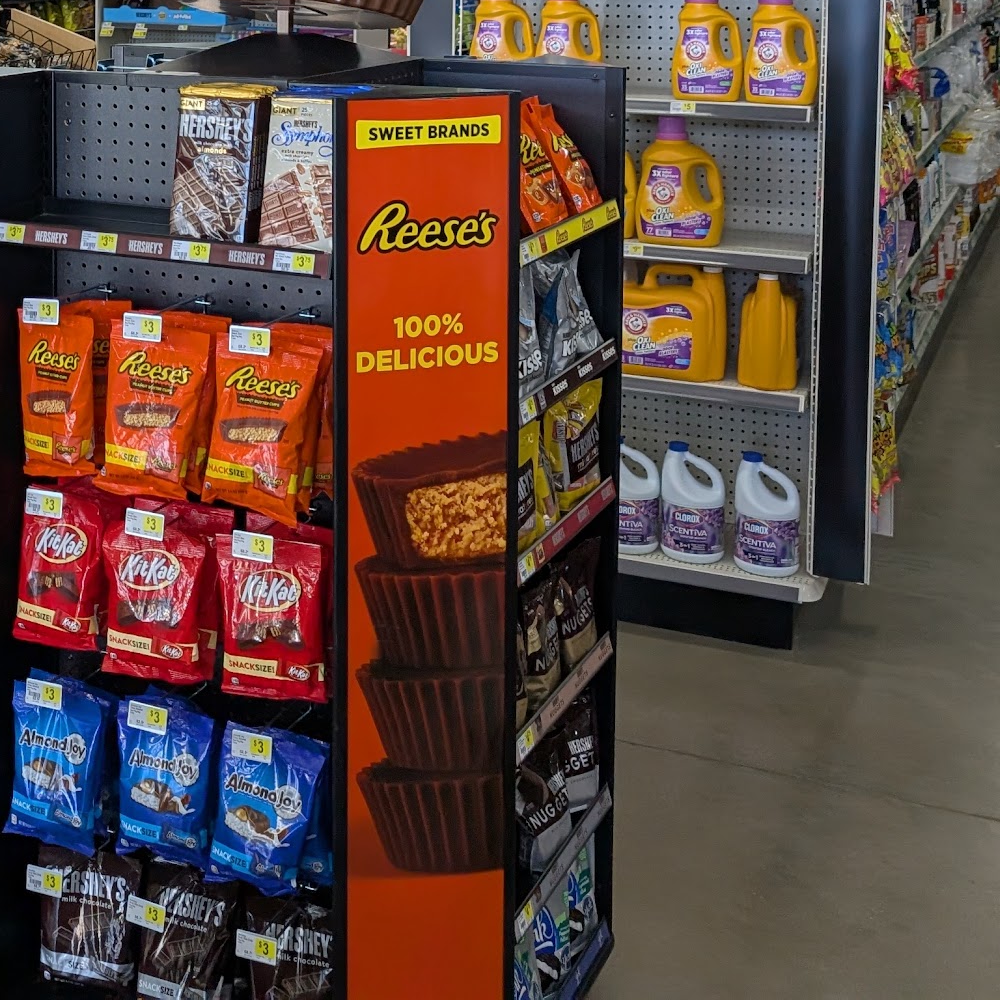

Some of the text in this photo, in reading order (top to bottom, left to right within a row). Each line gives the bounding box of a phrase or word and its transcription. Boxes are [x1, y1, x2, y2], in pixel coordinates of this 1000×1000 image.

[180, 114, 254, 142] HERSHEY'S
[294, 120, 318, 128] HERSHEY'S
[368, 123, 490, 141] SWEET BRANDS
[356, 200, 498, 254] Reese's
[652, 213, 675, 222] CLEAN
[35, 230, 68, 244] HERSHEY'S
[128, 239, 163, 254] HERSHEY'S
[228, 250, 266, 266] HERSHEY'S
[394, 313, 464, 339] 100%
[28, 340, 80, 371] Reese's
[356, 341, 498, 374] DELICIOUS
[633, 342, 656, 351] CLEAN
[120, 352, 192, 384] Reese's
[226, 366, 301, 399] Reese's
[674, 512, 700, 523] CLOROX
[744, 522, 769, 535] CLOROX
[18, 729, 86, 759] Almond Joy
[128, 748, 198, 780] Almond Joy
[224, 773, 277, 800] Almond
[79, 898, 112, 910] chocolate
